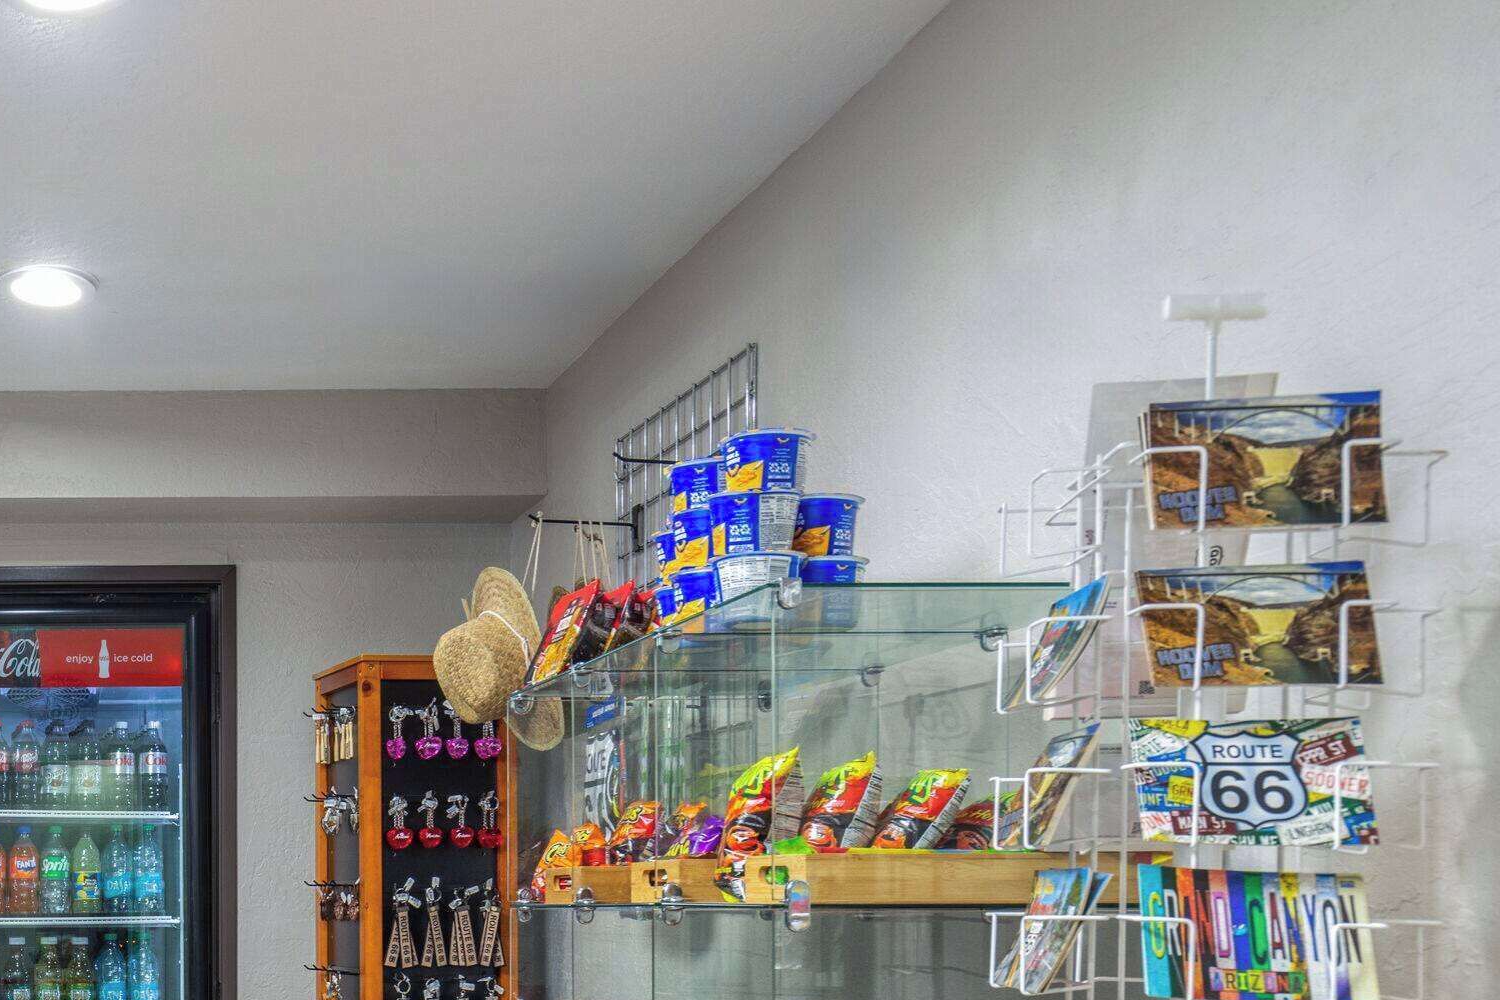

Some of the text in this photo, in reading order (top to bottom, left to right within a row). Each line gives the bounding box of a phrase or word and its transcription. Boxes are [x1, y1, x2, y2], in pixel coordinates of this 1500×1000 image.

[65, 653, 153, 665] enjoy ice cold
[1212, 744, 1284, 759] ROUTE
[1210, 770, 1295, 814] 66
[1148, 889, 1363, 967] GRAND CANYON
[1210, 970, 1308, 994] ARIZONA
